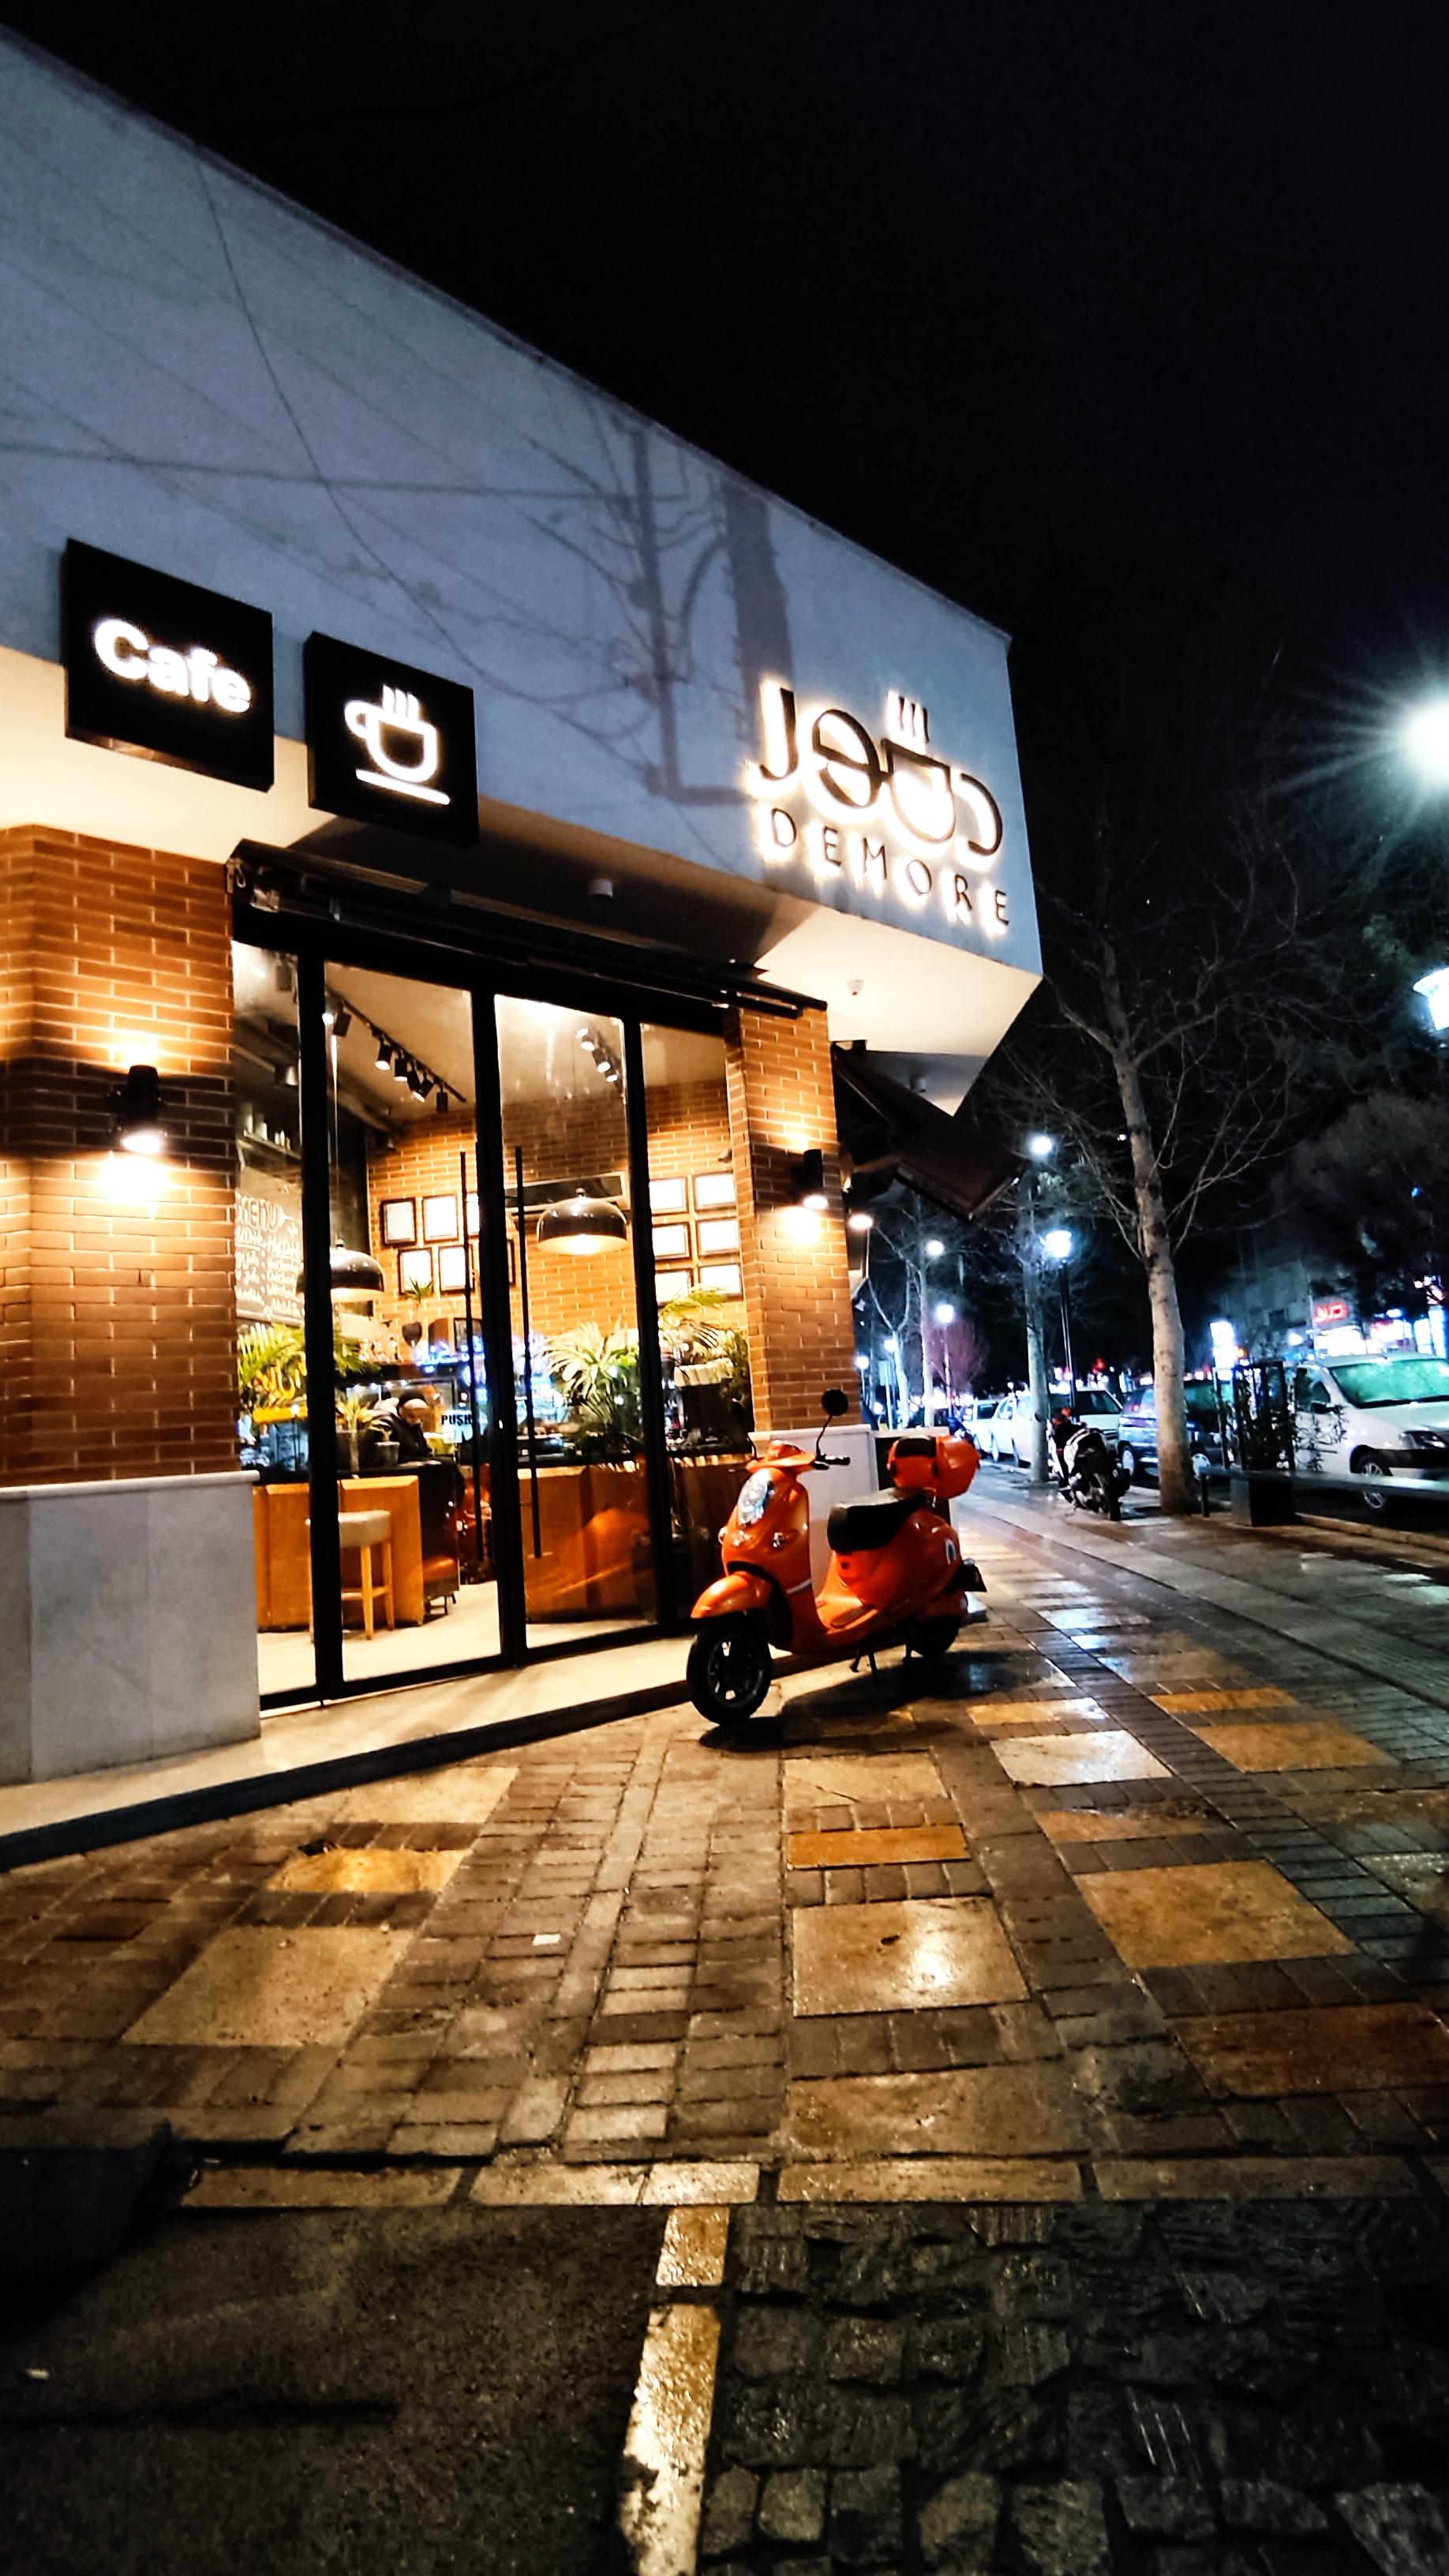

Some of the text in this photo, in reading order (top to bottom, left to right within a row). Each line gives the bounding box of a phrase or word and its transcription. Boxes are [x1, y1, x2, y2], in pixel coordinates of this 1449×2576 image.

[93, 617, 252, 713] Cafe
[770, 807, 1009, 927] DEMORE
[441, 1413, 472, 1426] PUSH
